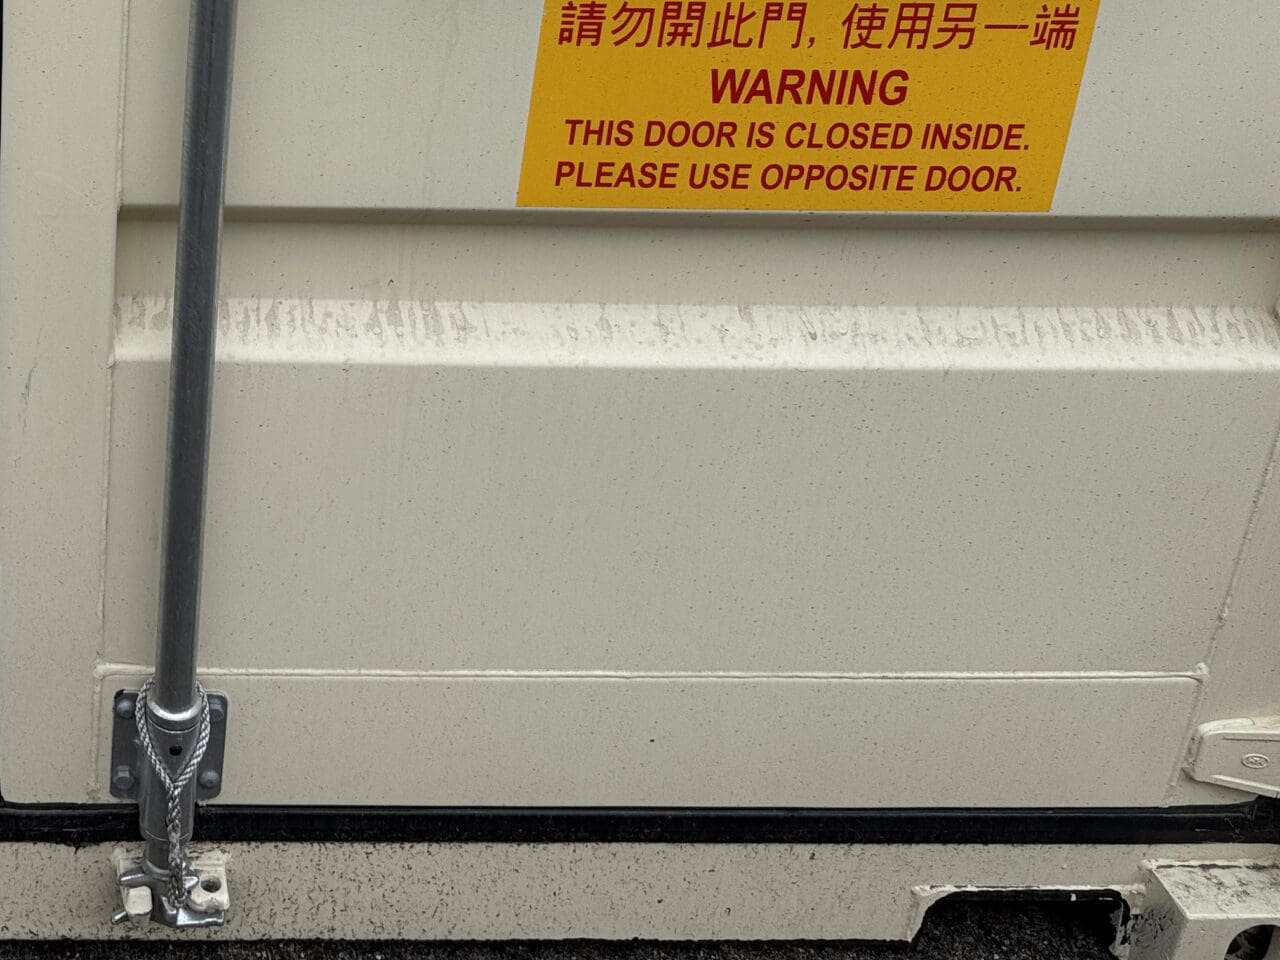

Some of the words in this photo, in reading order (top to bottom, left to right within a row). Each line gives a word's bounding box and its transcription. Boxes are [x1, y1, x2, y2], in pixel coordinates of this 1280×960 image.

[710, 68, 910, 107] WARNING
[564, 119, 635, 147] THIS
[643, 120, 738, 149] DOOR
[746, 121, 776, 149] IS
[784, 121, 913, 150] CLOSED
[920, 123, 1030, 151] INSIDE.
[554, 160, 680, 189] PLEASE
[688, 163, 753, 190] USE
[760, 163, 918, 192] OPPOSITE
[924, 165, 1023, 193] DOOR.
